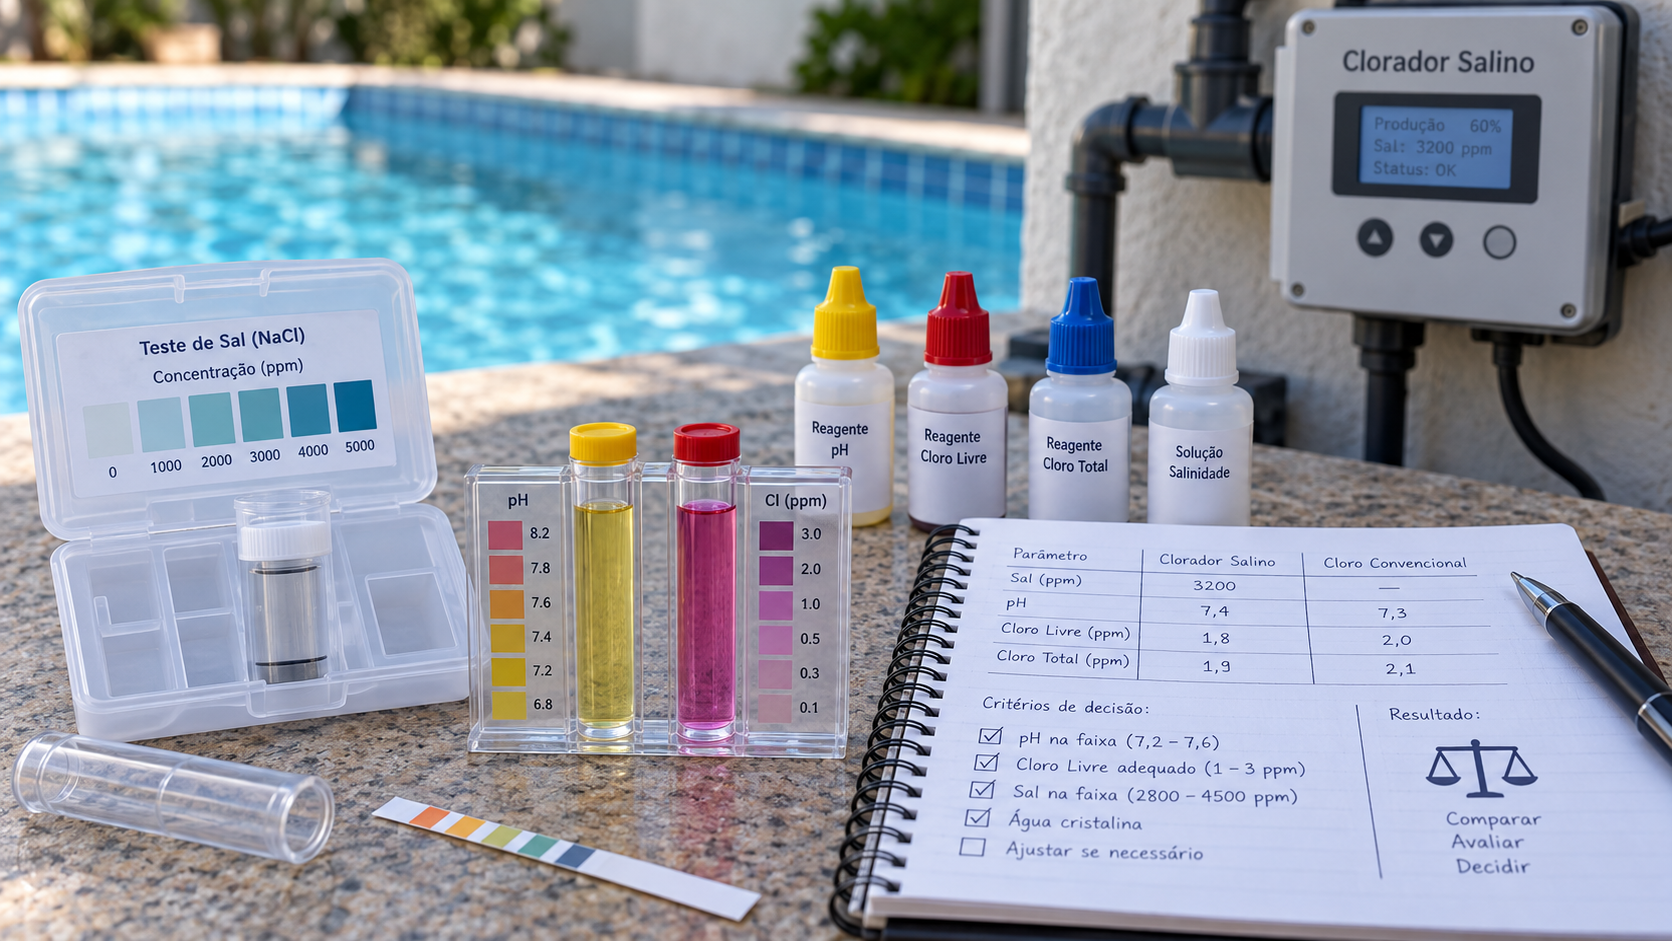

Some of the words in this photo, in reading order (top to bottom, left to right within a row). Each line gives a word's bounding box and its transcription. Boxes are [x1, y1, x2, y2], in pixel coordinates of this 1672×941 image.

[1343, 50, 1450, 72] Clorador
[1458, 50, 1534, 73] Salino
[1375, 117, 1445, 134] Produção
[1470, 119, 1501, 133] 60%
[1374, 139, 1405, 153] Sal:
[1417, 140, 1454, 154] 3200
[1462, 145, 1492, 158] ppm
[1374, 161, 1428, 176] Status:
[1436, 163, 1456, 176] OK
[139, 340, 186, 355] Teste
[193, 336, 213, 350] de
[220, 332, 245, 348] Sal
[252, 327, 304, 349] (NaCl)
[154, 363, 255, 383] Concentração
[261, 358, 303, 376] (ppm)
[813, 421, 868, 438] Reagente
[925, 429, 980, 446] Reagente
[832, 444, 848, 459] pH
[1048, 436, 1102, 454] Reagente
[109, 467, 117, 478] 0
[151, 459, 181, 473] 1000
[202, 454, 232, 467] 2000
[250, 449, 280, 462] 3000
[299, 444, 328, 457] 4000
[346, 440, 374, 452] 5000
[921, 450, 952, 464] Cloro
[957, 452, 986, 464] Livre
[1176, 446, 1223, 462] Solução
[1044, 457, 1074, 472] Cloro
[1078, 459, 1107, 472] Total
[1170, 465, 1230, 479] Salinidade
[509, 494, 528, 509] pH
[766, 494, 779, 506] Cl
[785, 494, 826, 510] (ppm)
[531, 527, 549, 539] 8.2
[802, 528, 821, 539] 3.0
[1014, 548, 1087, 561] Parâmetro
[1160, 554, 1222, 565] Clorador
[1231, 556, 1275, 566] Salino
[531, 562, 550, 573] 7.8
[802, 563, 821, 574] 2.0
[1324, 557, 1362, 568] Cloro
[1370, 557, 1466, 568] Convencional
[1011, 573, 1032, 583] Sal
[1040, 574, 1081, 587] (ppm)
[1194, 581, 1235, 591] 3200
[532, 597, 551, 608] 7.6
[802, 598, 820, 609] 1.0
[1007, 598, 1026, 610] pH
[1201, 606, 1229, 618] 7,4
[1379, 608, 1406, 620] 7,3
[533, 631, 551, 642] 7.4
[801, 633, 820, 644] 0.5
[1002, 622, 1038, 634] Cloro
[1046, 625, 1081, 637] Livre
[1088, 626, 1130, 641] (ppm)
[1203, 633, 1229, 645] 1,8
[1383, 635, 1411, 647] 2,0
[997, 650, 1035, 662] Cloro
[1043, 652, 1078, 664] Total
[1086, 653, 1129, 669] (ppm)
[533, 665, 552, 676] 7.2
[800, 668, 819, 679] 0.3
[1204, 661, 1230, 674] 1,9
[1386, 663, 1415, 676] 2,1
[534, 699, 552, 710] 6.8
[800, 702, 817, 713] 0.1
[983, 696, 1049, 711] Critérios
[1059, 700, 1076, 712] de
[1085, 701, 1148, 714] decisão:
[1390, 708, 1479, 720] Resultado:
[1020, 732, 1040, 748] pH
[1050, 737, 1068, 745] na
[1077, 733, 1116, 746] faixa
[1127, 734, 1162, 749] (7,2
[1184, 735, 1219, 751] 7,6)
[1017, 758, 1058, 771] Cloro
[1068, 760, 1108, 772] Livre
[1118, 761, 1195, 778] adequado
[1205, 761, 1222, 777] (1
[1245, 763, 1255, 775] 3
[1264, 762, 1305, 779] ppm)
[1014, 785, 1038, 798] Sal
[1049, 791, 1067, 799] na
[1076, 786, 1117, 800] faixa
[1128, 787, 1179, 803] (2800
[1202, 790, 1245, 802] 4500
[1255, 789, 1297, 807] ppm)
[1009, 810, 1051, 832] Água
[1061, 816, 1142, 830] cristalina
[1447, 812, 1541, 830] Comparar
[1452, 834, 1524, 848] Avaliar
[1006, 841, 1072, 860] Ajustar
[1082, 848, 1099, 858] se
[1110, 845, 1203, 860] necessário
[1456, 858, 1530, 873] Decidir
